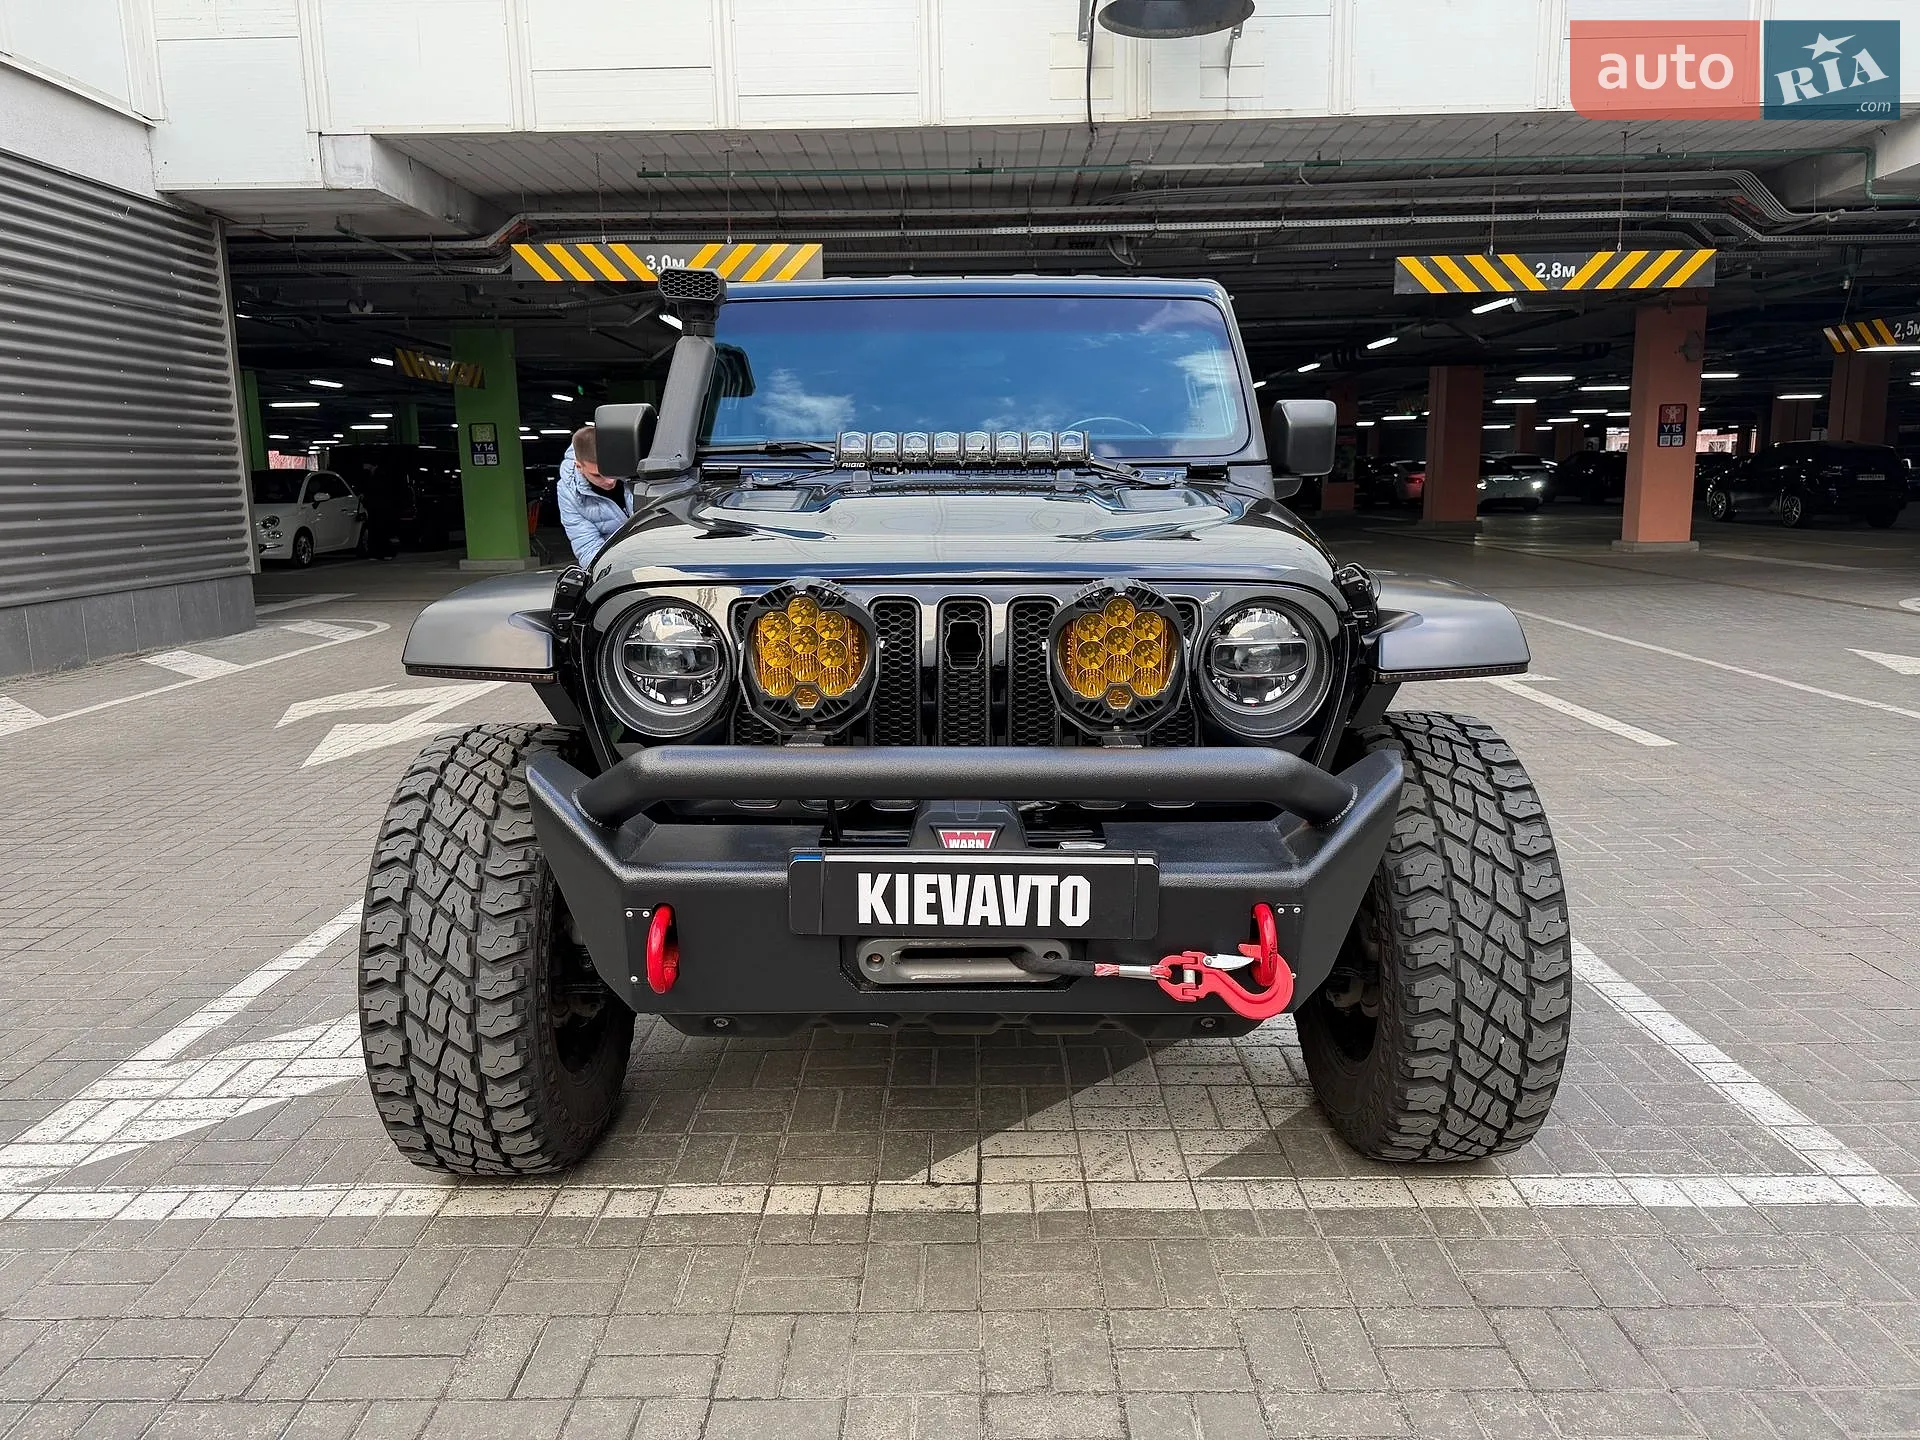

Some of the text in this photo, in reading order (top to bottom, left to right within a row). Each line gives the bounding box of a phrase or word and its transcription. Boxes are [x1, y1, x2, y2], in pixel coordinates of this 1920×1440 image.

[1663, 424, 1681, 433] Y 15
[475, 443, 494, 451] Y 14
[948, 838, 985, 849] WARN
[857, 872, 1091, 927] KIEVAVTO
